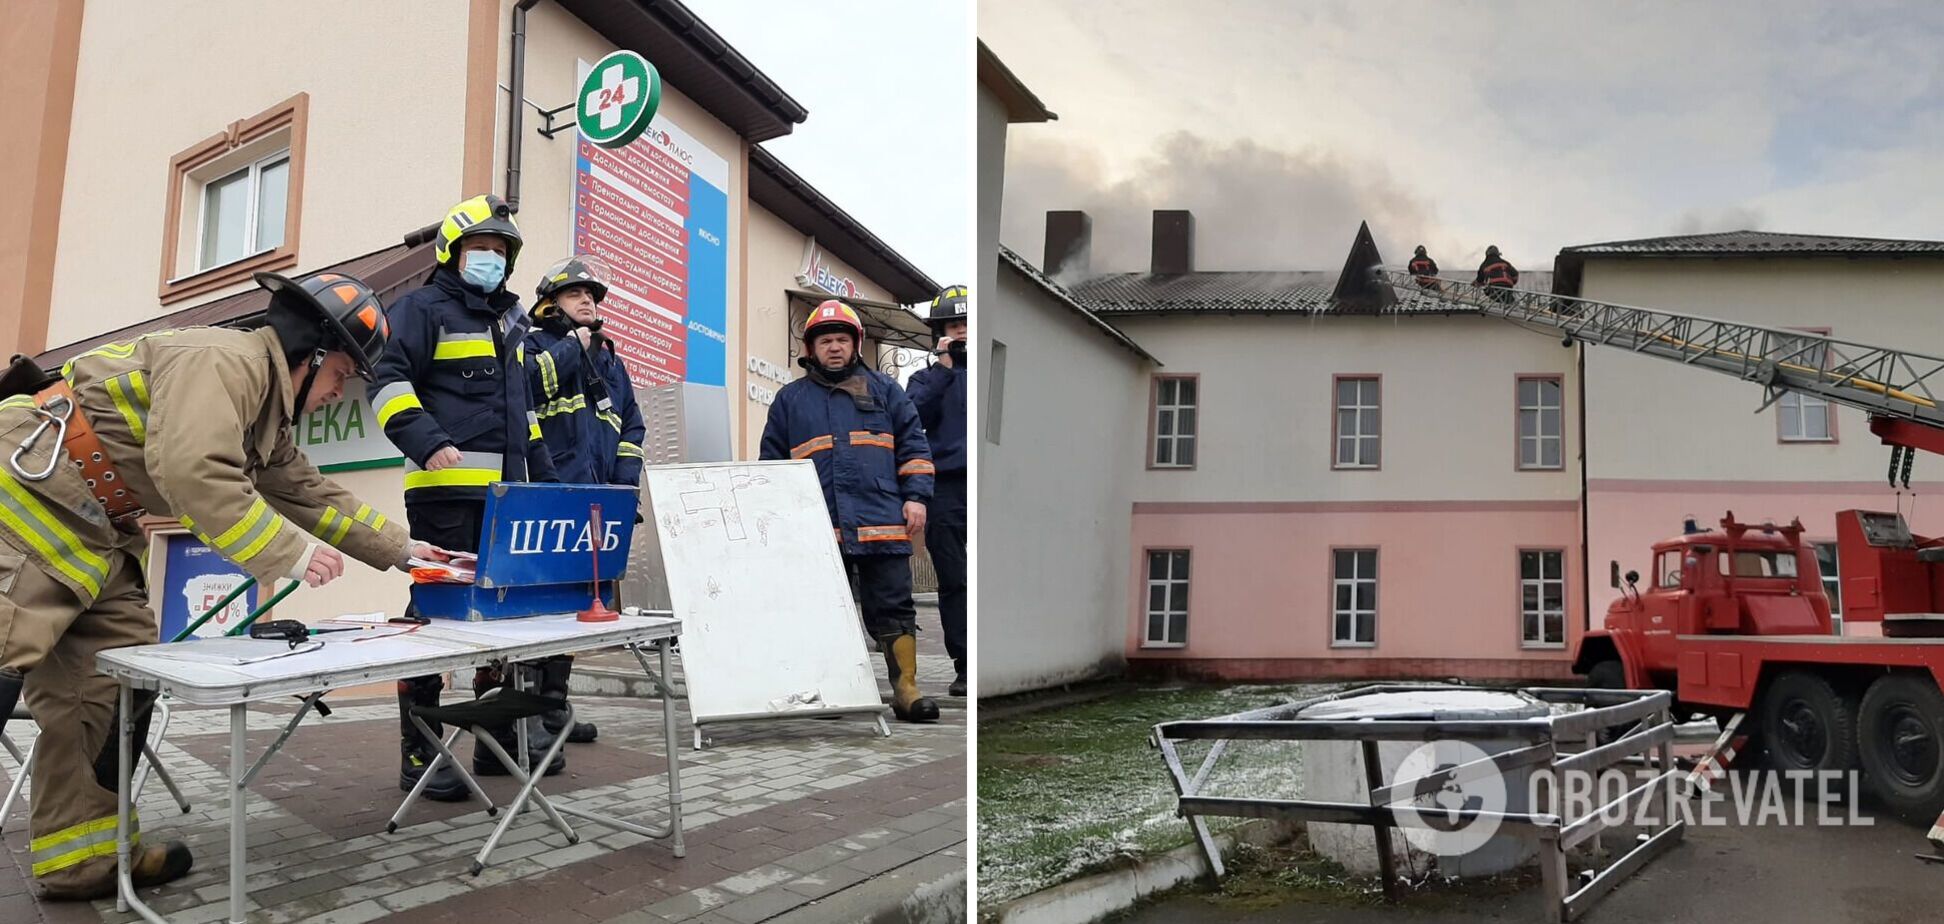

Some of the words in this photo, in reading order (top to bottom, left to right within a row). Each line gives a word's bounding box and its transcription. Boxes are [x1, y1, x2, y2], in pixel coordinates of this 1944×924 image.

[598, 84, 625, 110] 24
[644, 126, 663, 145] ЕКС
[592, 151, 640, 186] Дослідження
[591, 179, 640, 213] Пренатальна
[590, 200, 636, 232] Гормональні
[589, 221, 633, 250] Онкологічні
[633, 245, 664, 266] маркери
[588, 240, 652, 279] Серцево-судинні
[651, 273, 681, 292] маркери
[510, 519, 622, 555] ШТАБ
